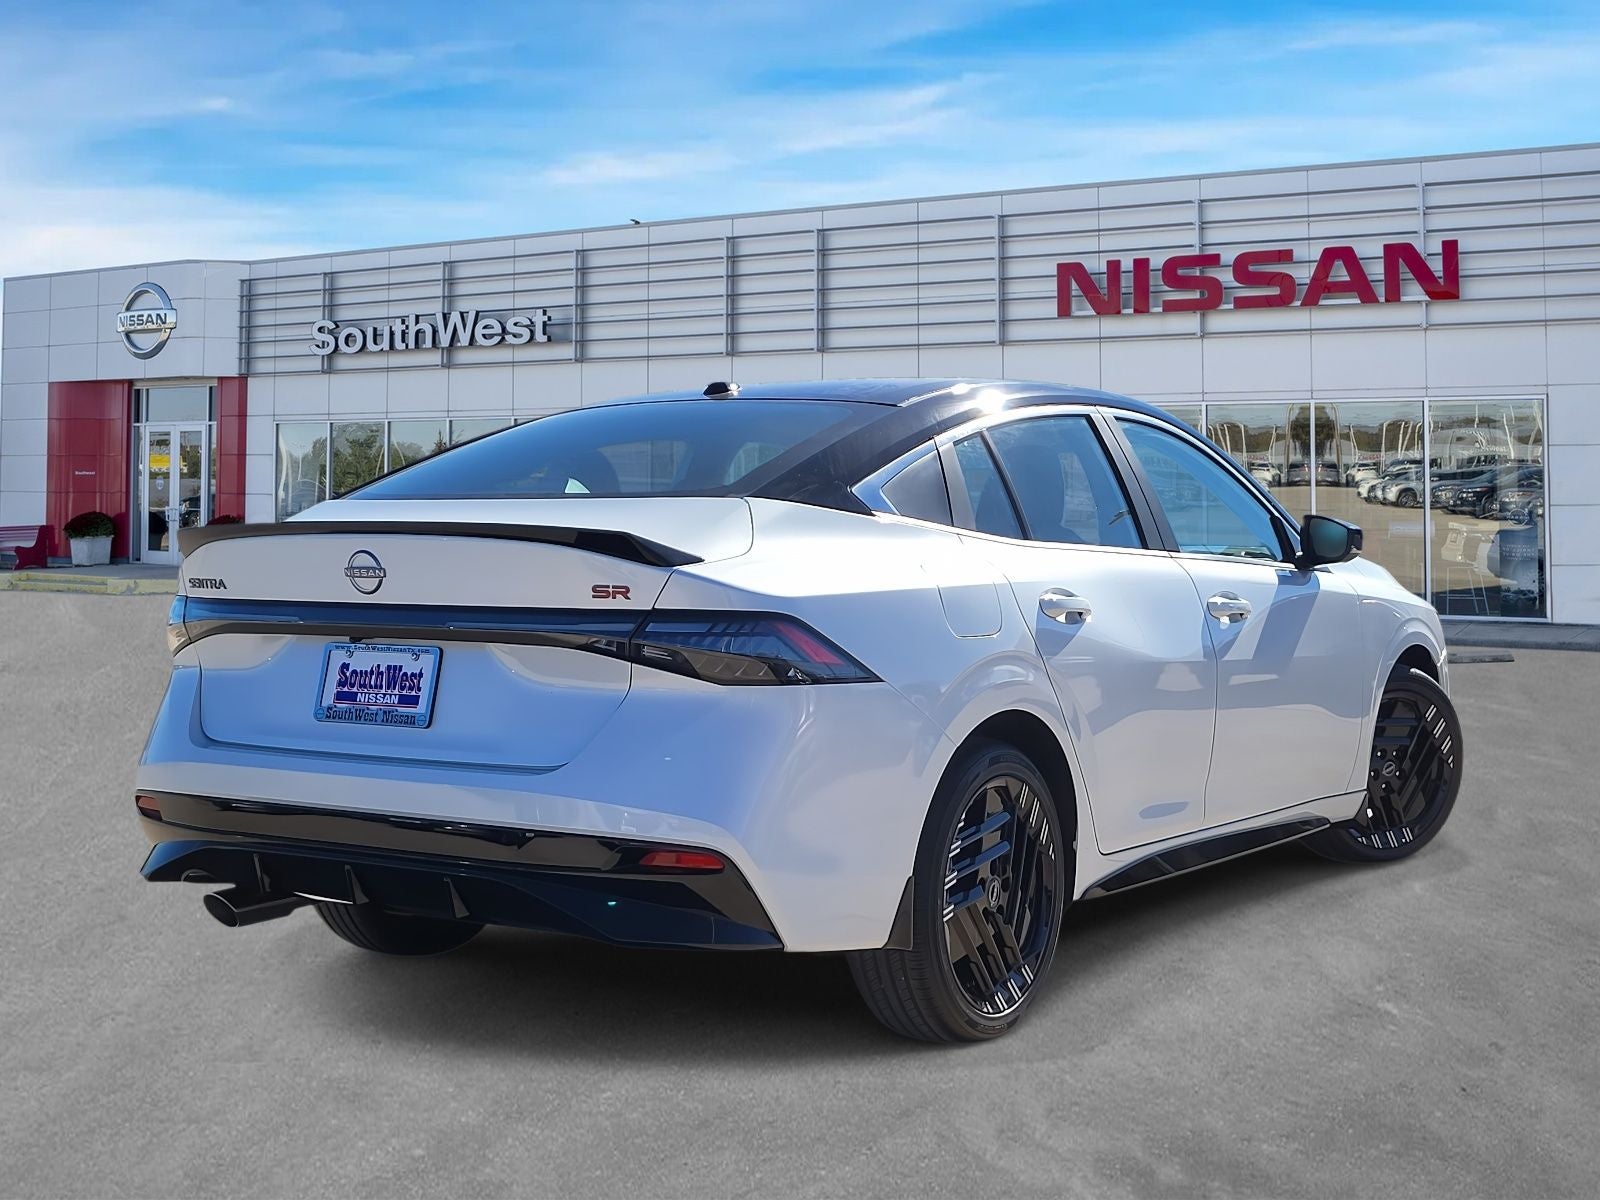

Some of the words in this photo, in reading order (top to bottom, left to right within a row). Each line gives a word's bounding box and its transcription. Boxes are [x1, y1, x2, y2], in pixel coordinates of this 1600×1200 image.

[1057, 239, 1460, 317] NISSAN
[119, 312, 168, 328] NISSAN
[310, 308, 551, 356] SouthWest
[344, 568, 385, 577] NISSAN
[188, 577, 228, 590] SENTRA
[591, 584, 632, 601] SR
[356, 693, 399, 704] NISSAN
[325, 705, 379, 722] SouthWest
[381, 709, 417, 726] Nissan
